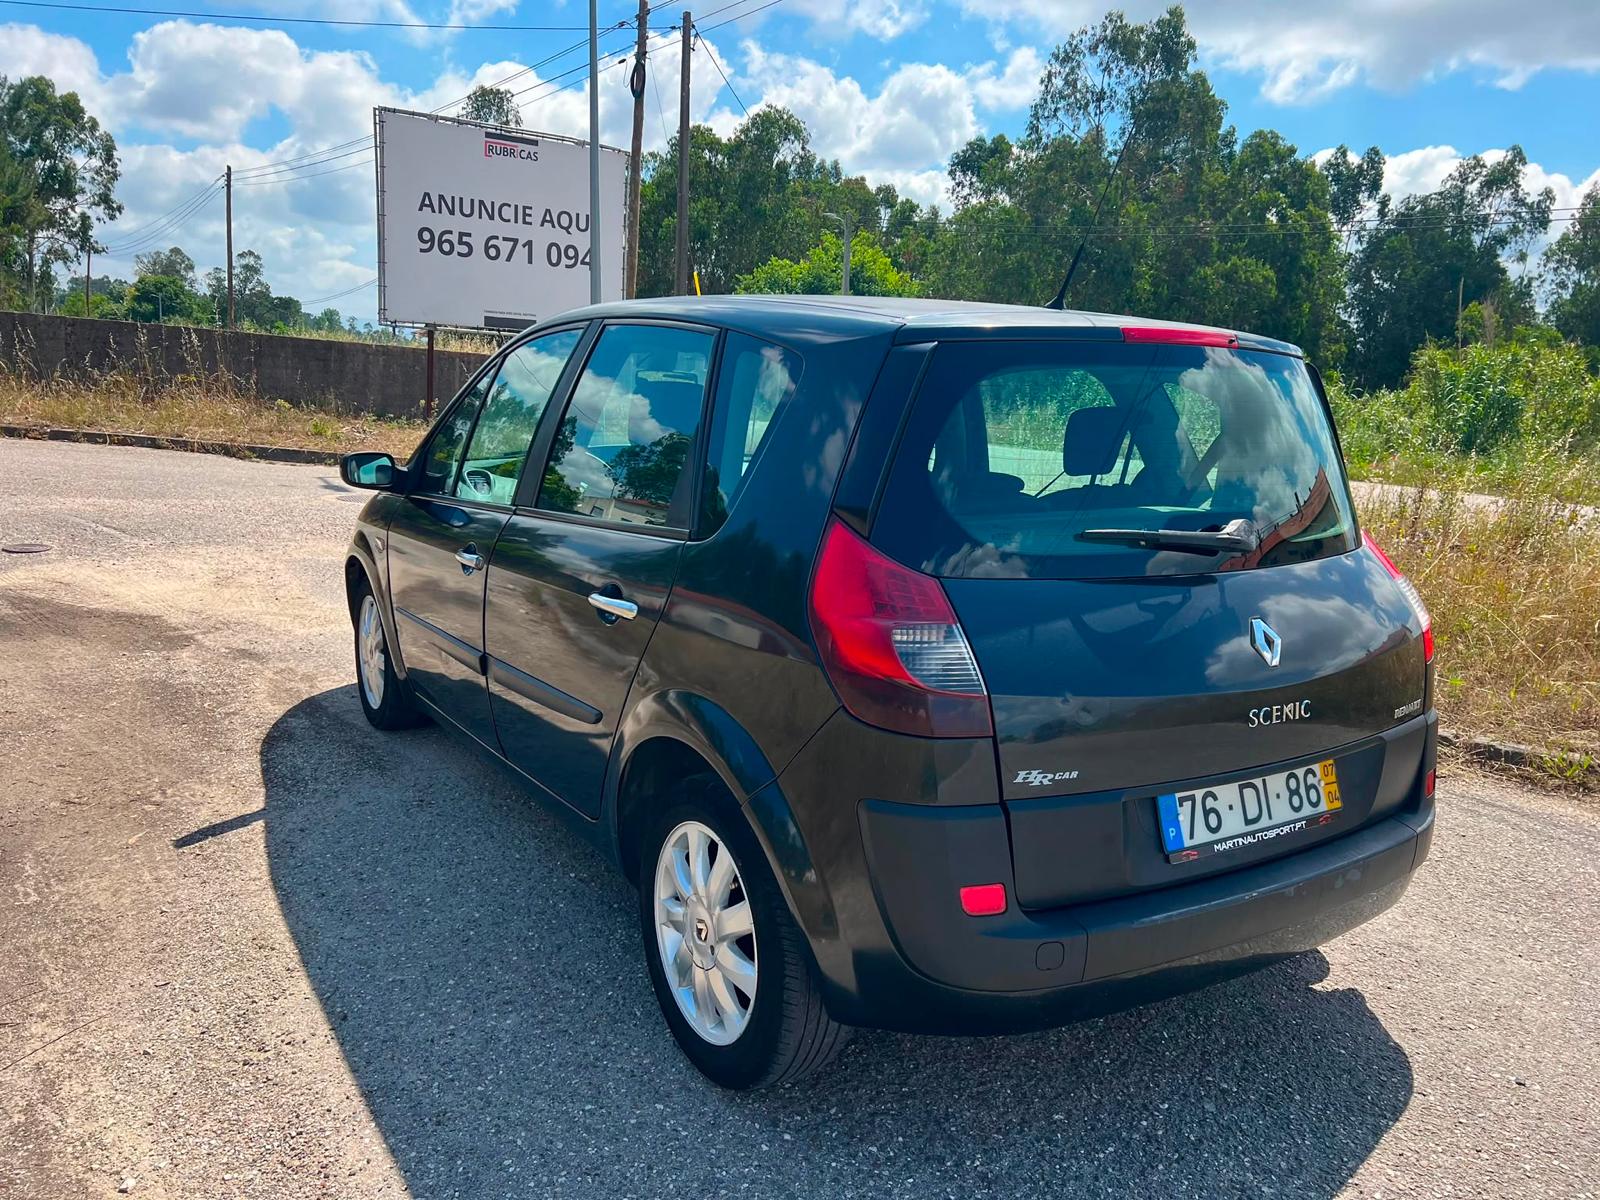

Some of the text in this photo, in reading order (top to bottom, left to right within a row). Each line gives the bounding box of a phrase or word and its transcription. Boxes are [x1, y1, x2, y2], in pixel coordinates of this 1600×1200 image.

[487, 144, 539, 161] RUBRICAS
[417, 191, 590, 235] ANUNCIE AQU
[417, 226, 592, 271] 965 671 094
[1248, 700, 1311, 728] SCENIC
[1054, 771, 1079, 780] CAR
[1322, 763, 1335, 778] 07
[1327, 791, 1340, 804] 04
[1168, 827, 1176, 841] P
[1213, 820, 1307, 853] MARTINAUTOSPORT.PT
